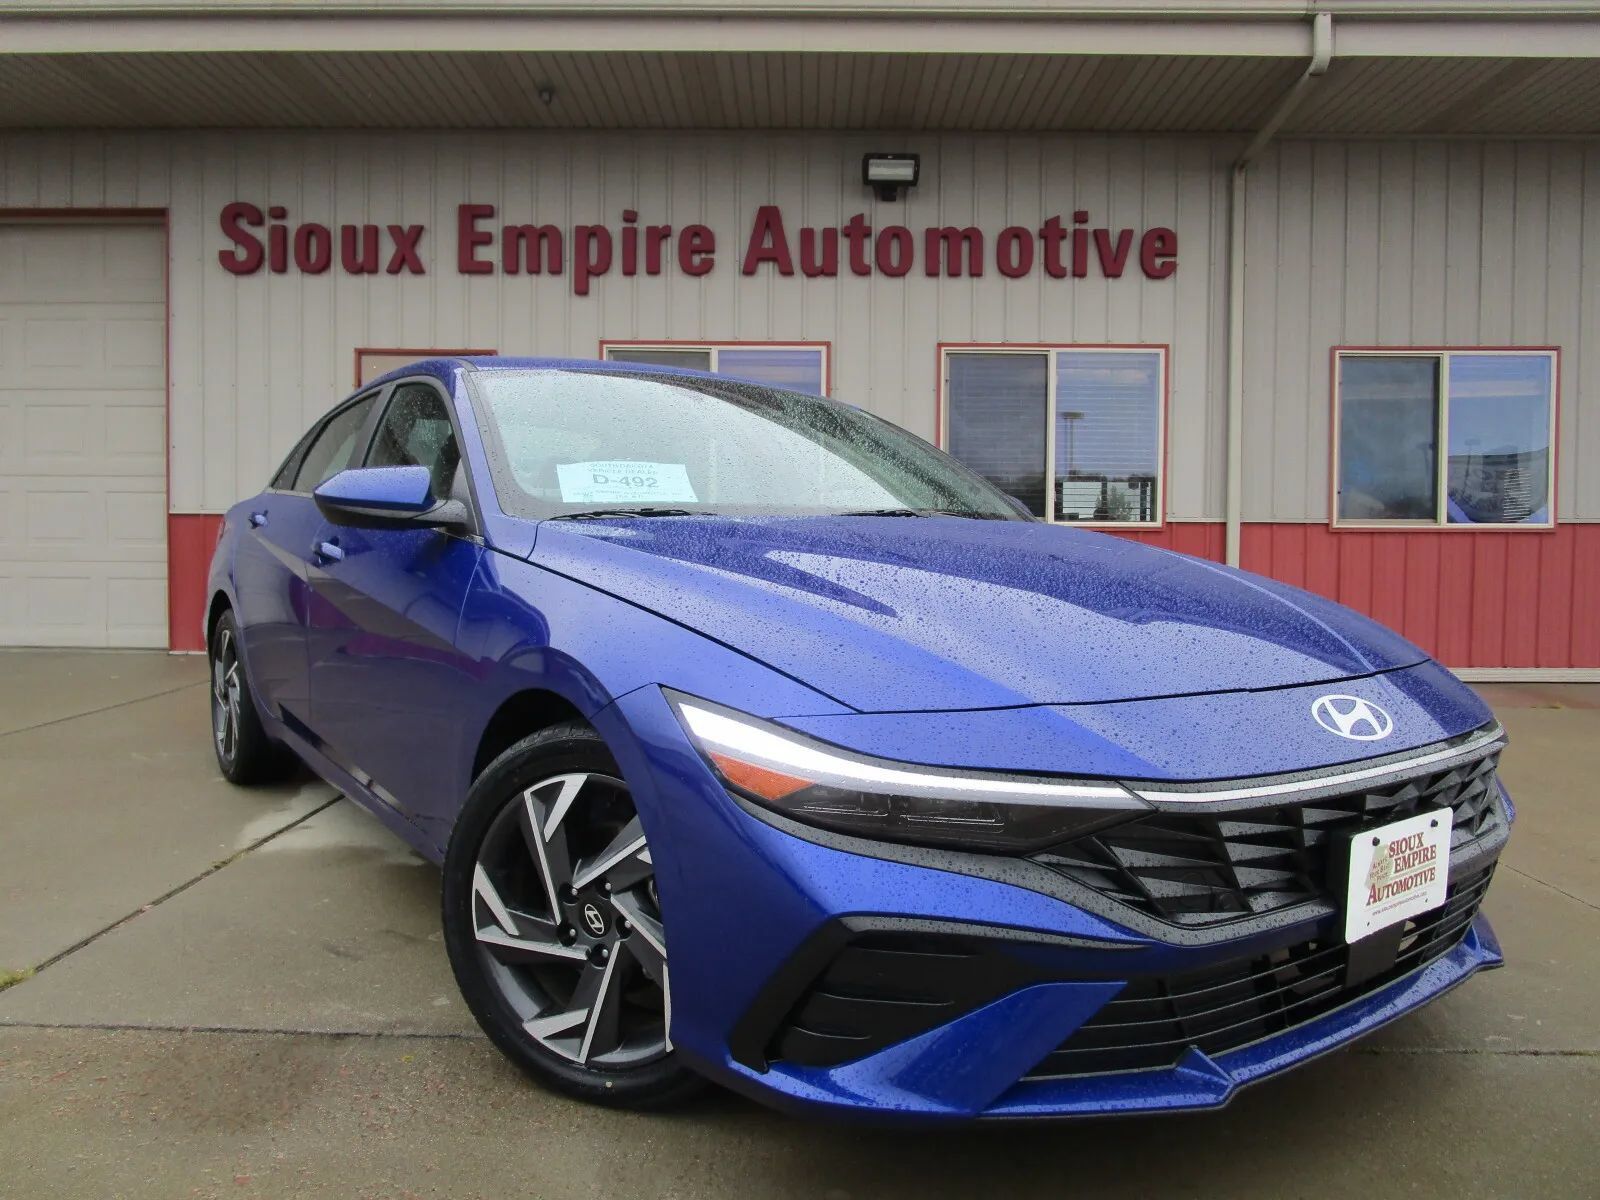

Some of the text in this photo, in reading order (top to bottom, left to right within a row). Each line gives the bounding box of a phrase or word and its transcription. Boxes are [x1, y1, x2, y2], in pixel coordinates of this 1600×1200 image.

[219, 202, 1178, 295] Sioux Empire Automotive
[592, 474, 660, 488] D-492
[1389, 832, 1424, 858] SIOUX
[1394, 844, 1437, 874] EMPIRE
[1366, 867, 1436, 907] AUTOMOTIVE
